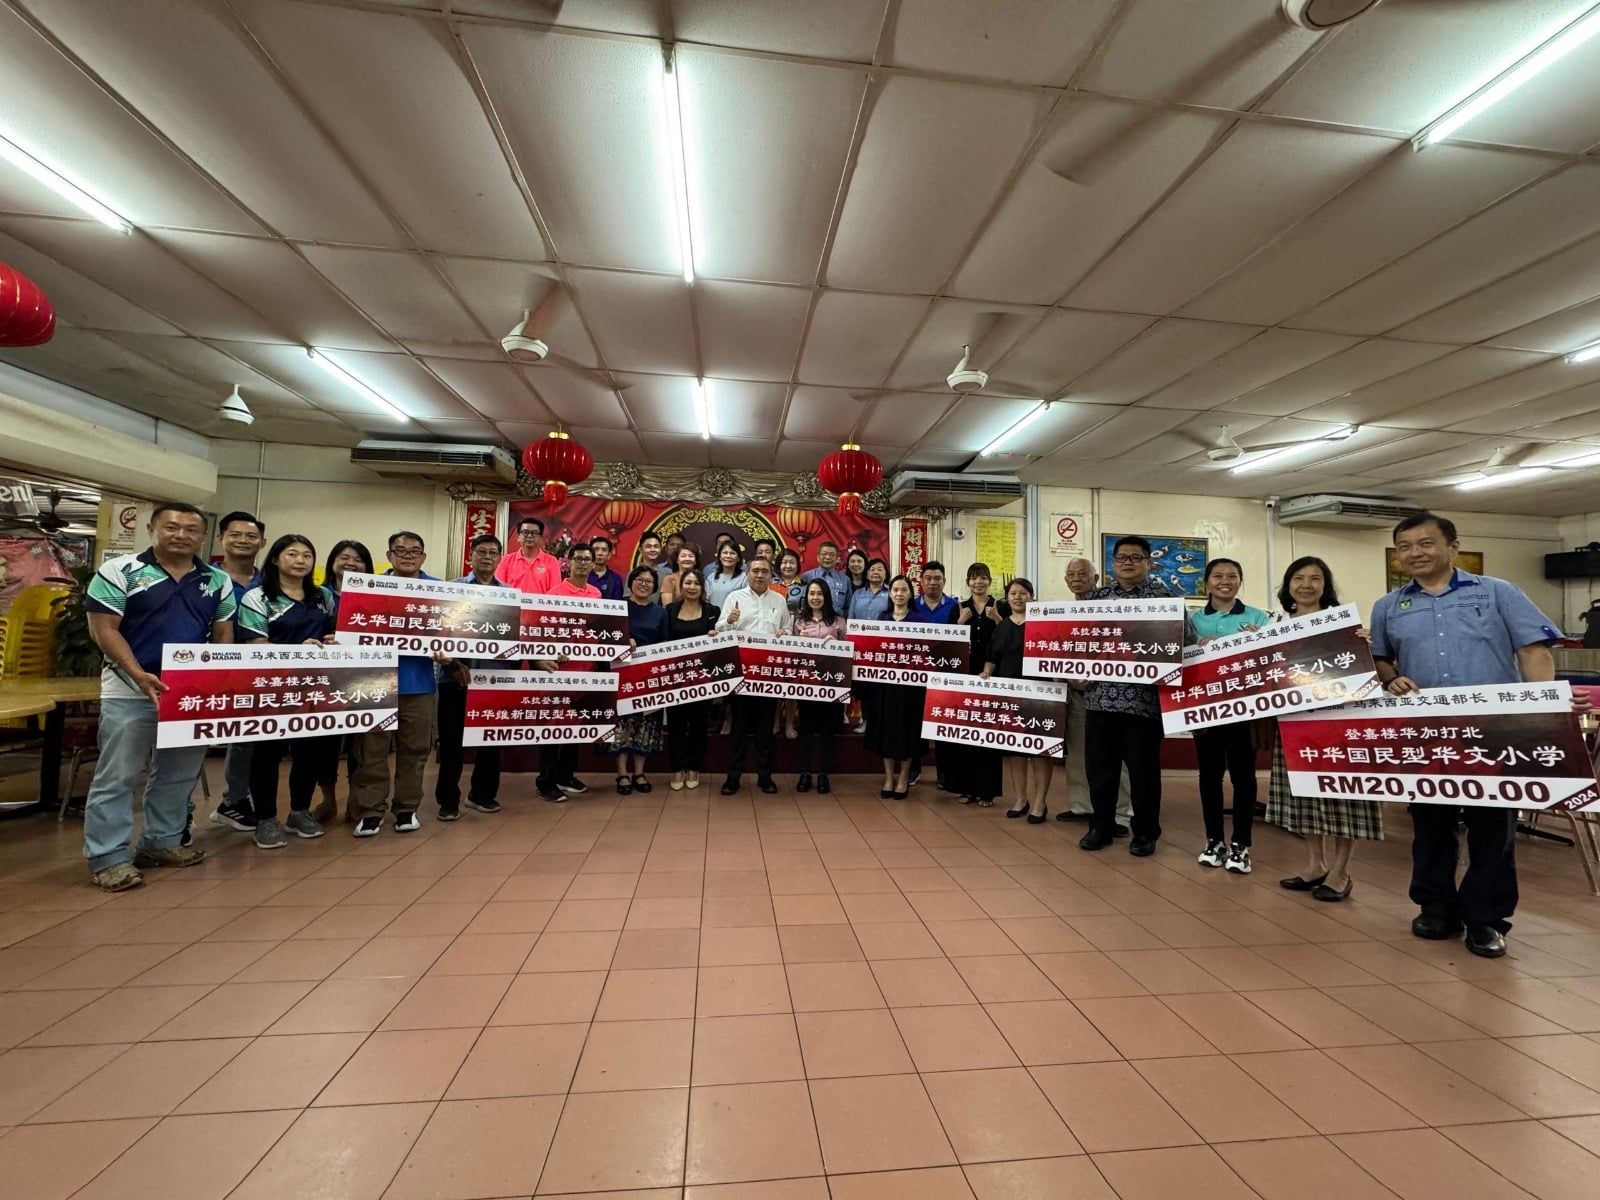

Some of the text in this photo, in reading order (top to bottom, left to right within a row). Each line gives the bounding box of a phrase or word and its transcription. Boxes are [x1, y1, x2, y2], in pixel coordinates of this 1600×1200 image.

[347, 612, 511, 636] 光华国民型华文小学
[1210, 609, 1351, 653] 马来西亚交通部长 陆兆福
[249, 650, 393, 661] 马来西亚交通部长 陆兆福
[358, 635, 500, 655] RM20,000.00
[1038, 660, 1159, 679] RM20,000.00
[1216, 651, 1287, 676] 登嘉楼日底
[251, 675, 331, 688] 登嘉楼龙运
[621, 662, 736, 693] 港口国民型华文小学
[1163, 671, 1181, 683] 2024
[1170, 651, 1357, 704] 中华国民型华文小学
[177, 687, 388, 713] 新村国民型华文小学
[631, 681, 731, 710] RM20,000.00
[744, 680, 836, 700] RM20,000.00
[1353, 688, 1560, 710] 马来西亚交通部长 陆兆福
[1357, 679, 1378, 700] 2024
[193, 712, 375, 741] RM20,000.00
[378, 715, 398, 732] 2024
[930, 706, 1057, 732] 乐群国民型华文小学
[482, 727, 599, 743] RM50,000.00
[936, 725, 1044, 751] RM20,000.00
[1344, 726, 1484, 741] 登嘉楼华加打北
[1047, 744, 1064, 755] 2024
[1299, 745, 1566, 768] 中华国民型华文小学
[1317, 775, 1551, 804] RM20,000.00
[1564, 789, 1598, 811] 2024
